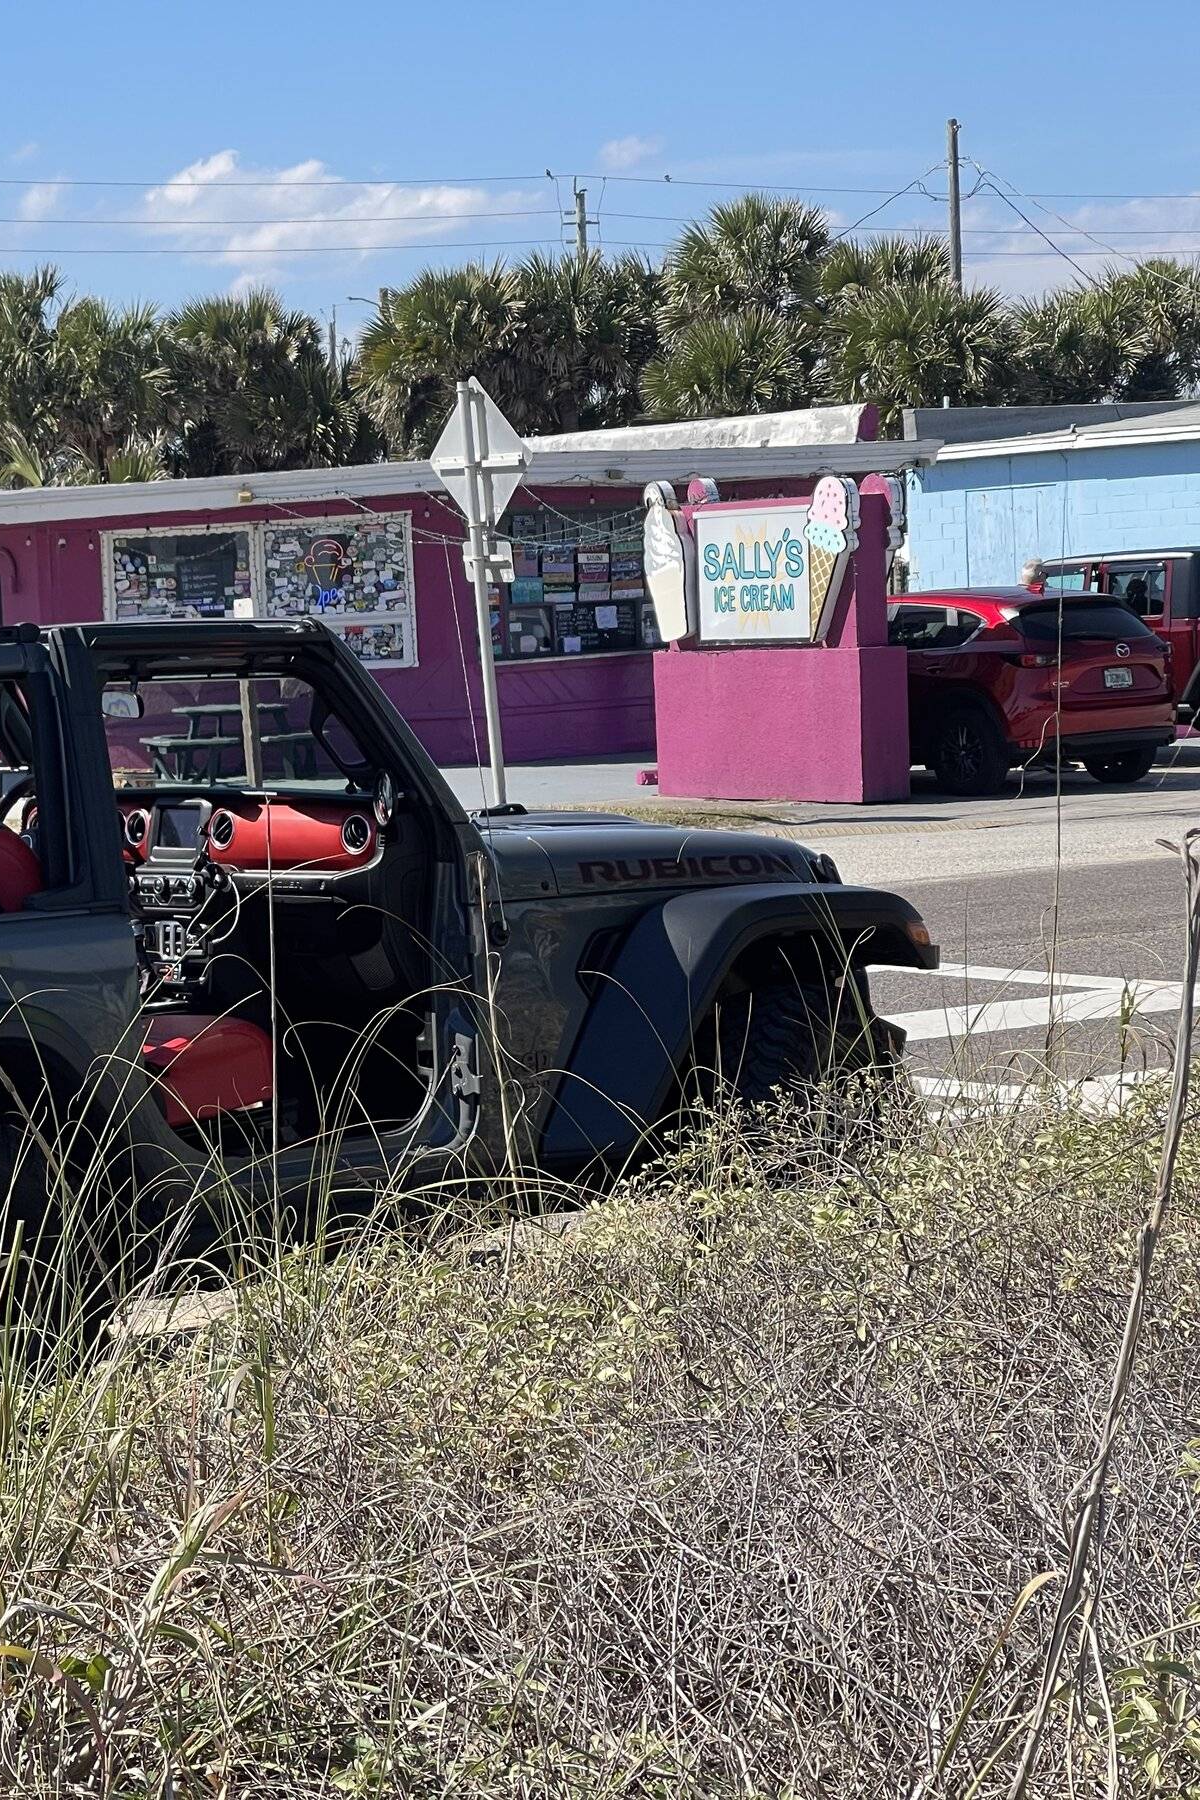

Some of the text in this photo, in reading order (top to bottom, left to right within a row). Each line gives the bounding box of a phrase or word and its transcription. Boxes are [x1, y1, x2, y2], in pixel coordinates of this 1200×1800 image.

[703, 528, 804, 582] SALLY'S
[714, 583, 795, 613] ICE CREAM
[576, 853, 794, 884] RUBICON
